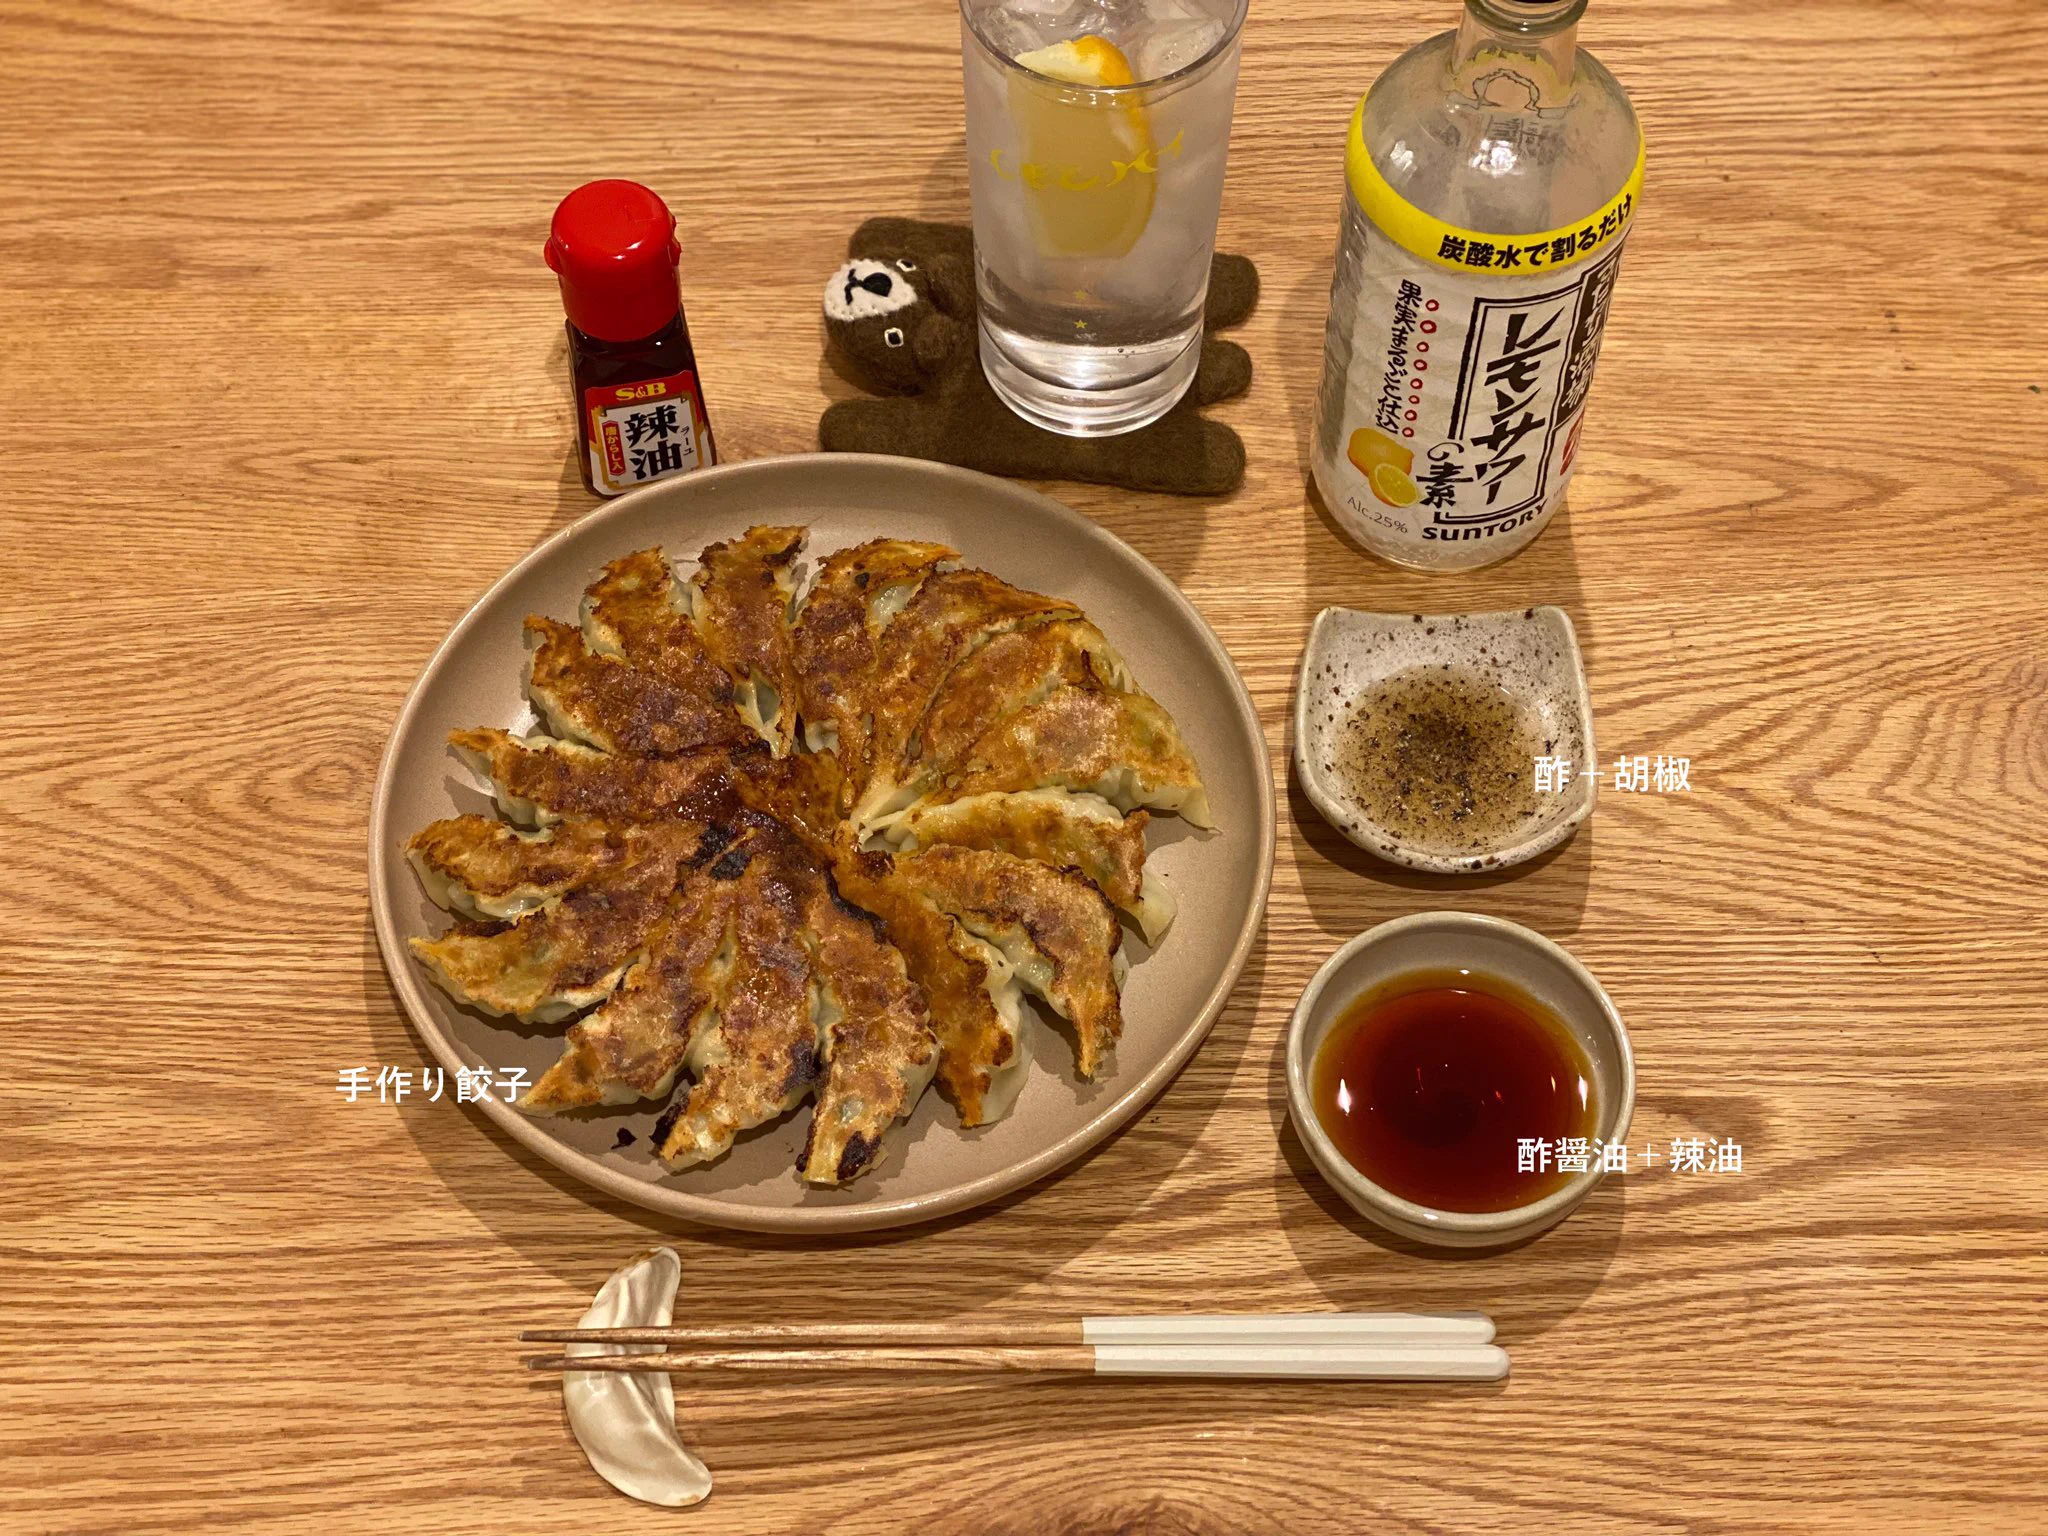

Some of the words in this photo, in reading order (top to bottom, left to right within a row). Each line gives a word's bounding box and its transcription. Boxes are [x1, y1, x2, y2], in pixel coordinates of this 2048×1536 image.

[1437, 193, 1633, 269] 炭酸水で割るだけ
[615, 382, 667, 401] S&B
[624, 404, 683, 480] 辣油
[1347, 496, 1408, 534] Alc.25%
[1422, 498, 1548, 541] SUNTORY
